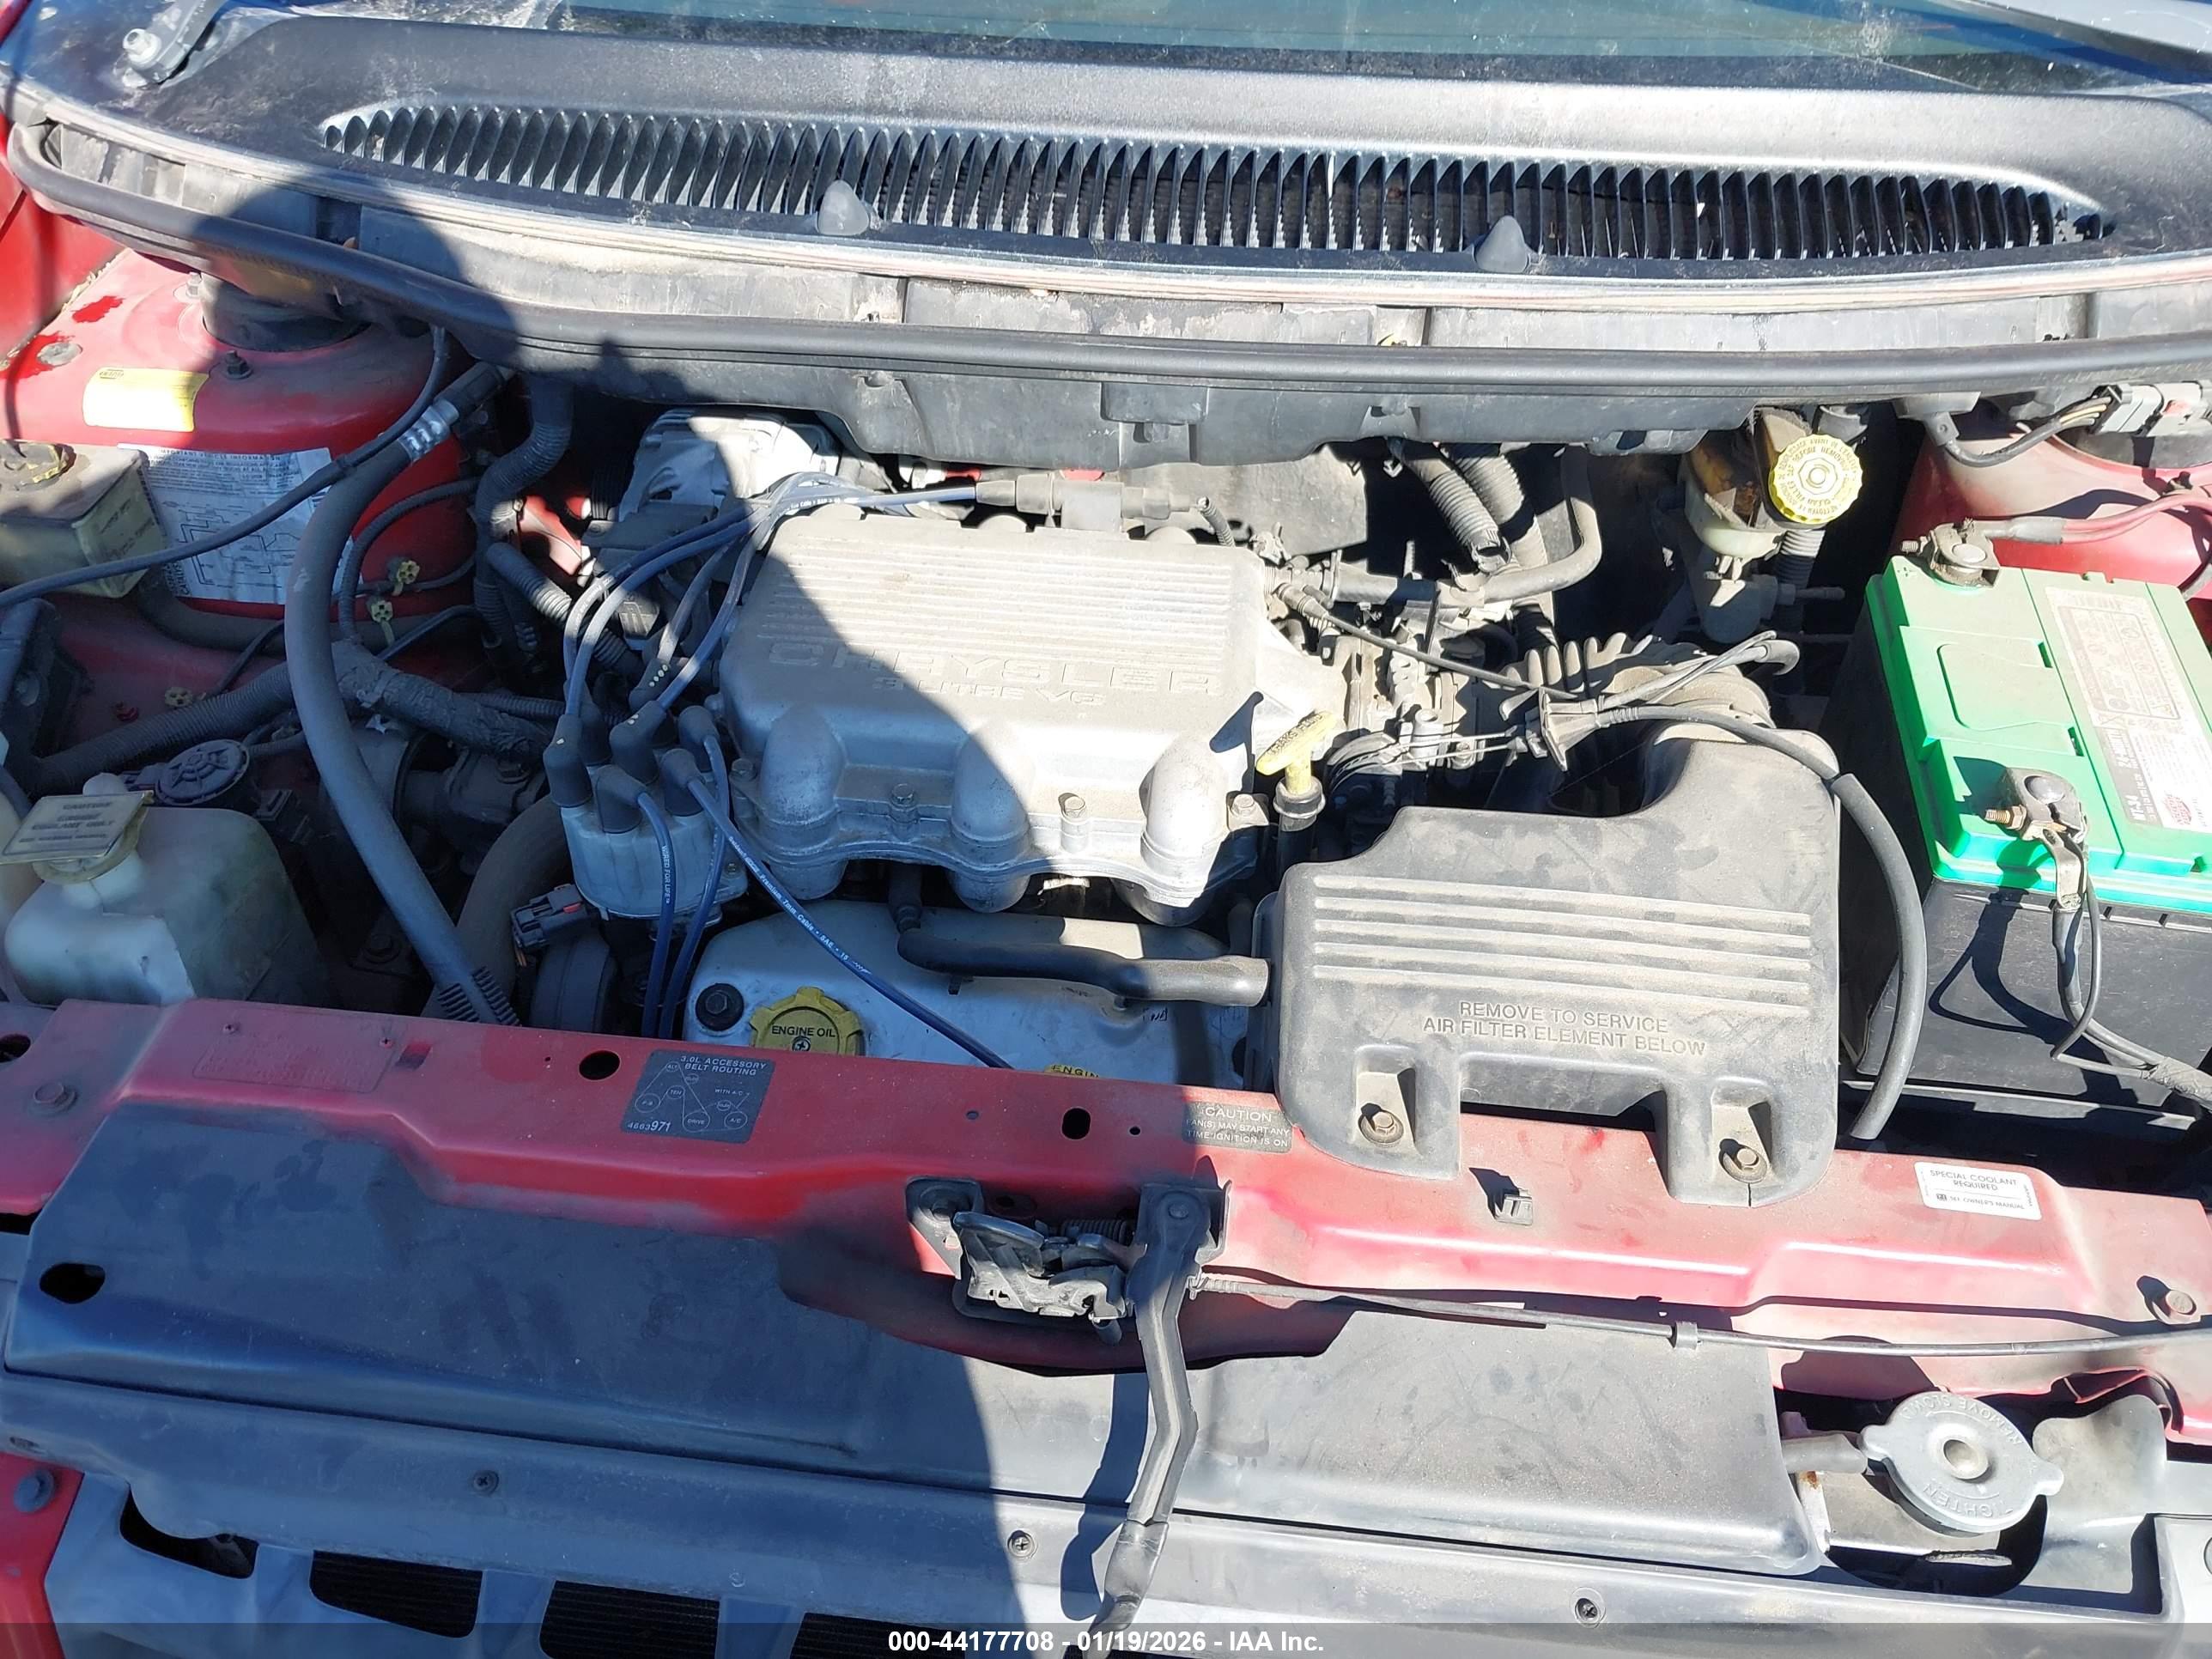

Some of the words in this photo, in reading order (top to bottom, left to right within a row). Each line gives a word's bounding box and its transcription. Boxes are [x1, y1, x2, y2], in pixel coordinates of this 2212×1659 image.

[769, 641, 1222, 696] CHRYSLER
[1459, 1001, 1545, 1022] REMOVE
[1550, 1008, 1578, 1024] TO
[1583, 1012, 1669, 1034] SERVICE
[771, 1025, 815, 1036] ENGINE
[817, 1026, 836, 1037] OIL
[1423, 1017, 1455, 1034] AIR
[1460, 1020, 1528, 1039] FILTER
[1534, 1025, 1628, 1048] ELEMENT
[1634, 1035, 1707, 1056] BELOW
[680, 1054, 700, 1064] 3.0L
[705, 1057, 767, 1070] ACCESSORY
[684, 1064, 709, 1073] BELT
[711, 1066, 757, 1076] ROUTING
[1205, 1107, 1272, 1122] CAUTION
[1218, 1121, 1238, 1130] MAY
[1239, 1124, 1269, 1134] START
[1188, 1129, 1211, 1139] TIME
[1213, 1132, 1258, 1145] IGNITION
[1273, 1139, 1289, 1147] ON
[1929, 1170, 1967, 1180] SPECIAL
[1970, 1174, 2018, 1186] COOLANT
[1953, 1180, 1999, 1191] REQUIRED
